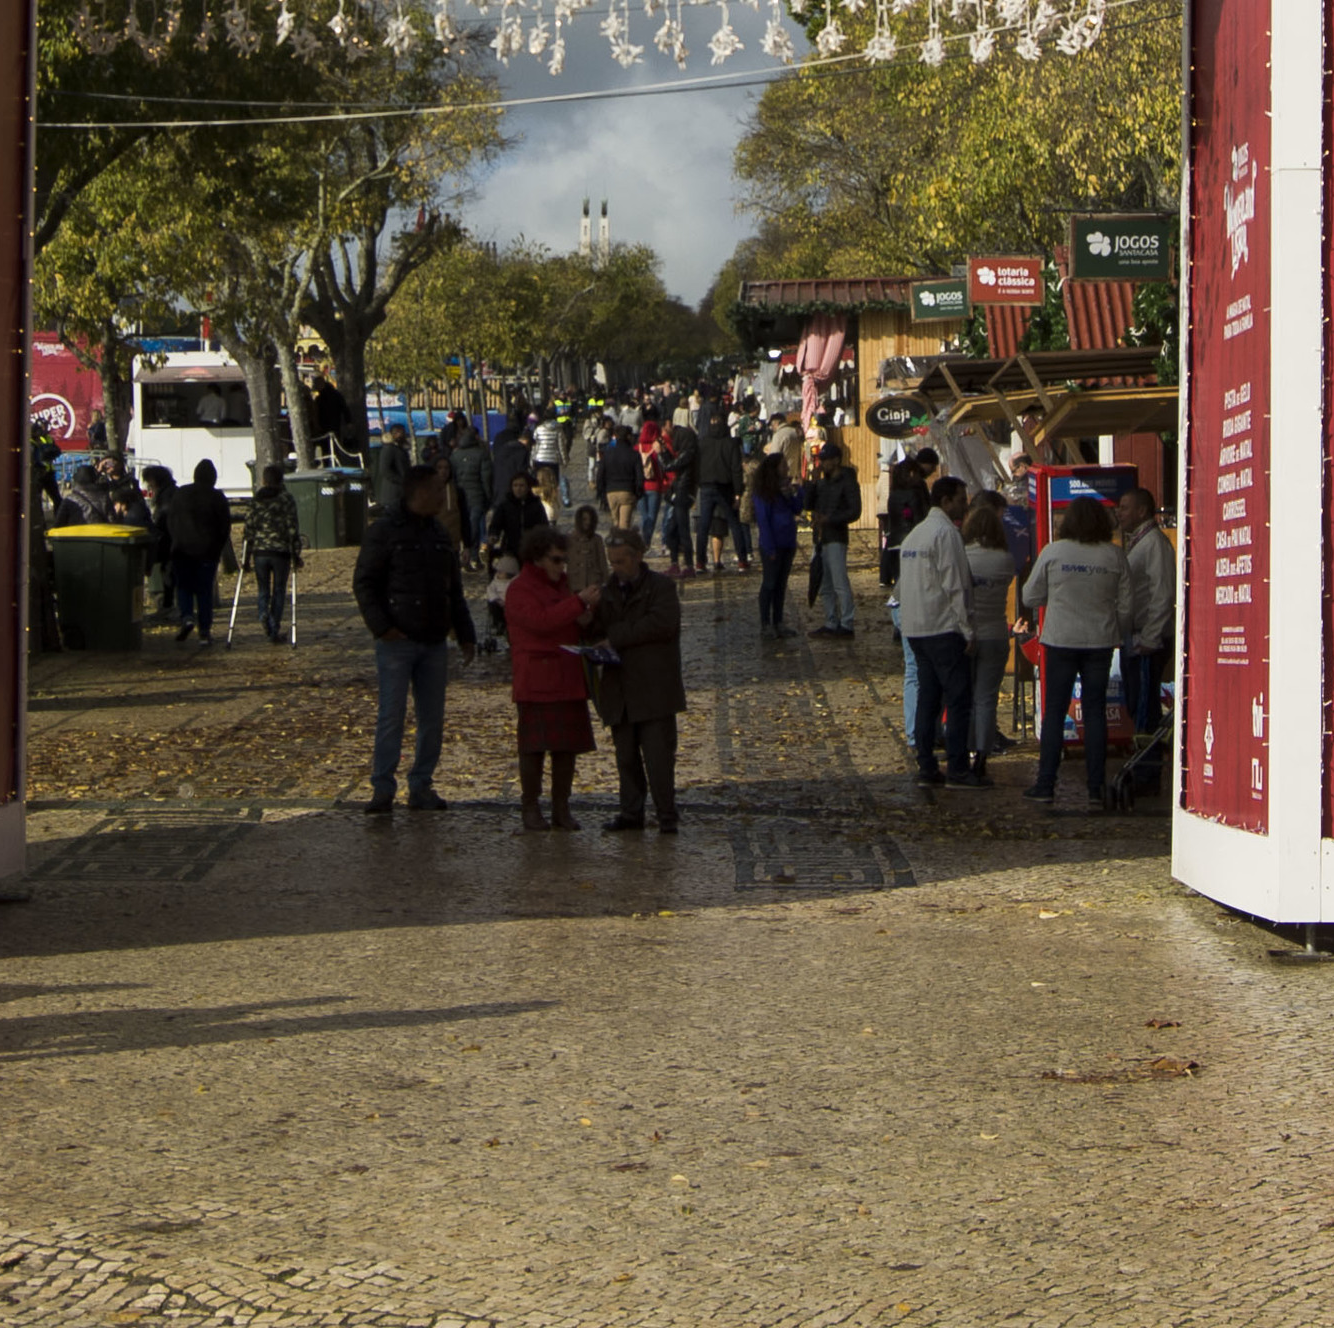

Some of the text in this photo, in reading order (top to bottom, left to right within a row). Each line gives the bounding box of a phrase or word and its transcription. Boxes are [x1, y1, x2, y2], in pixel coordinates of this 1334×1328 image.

[1114, 235, 1160, 253] JOGOS
[997, 267, 1029, 276] lotaria
[936, 291, 963, 304] JOGOS
[877, 408, 911, 424] Ginja
